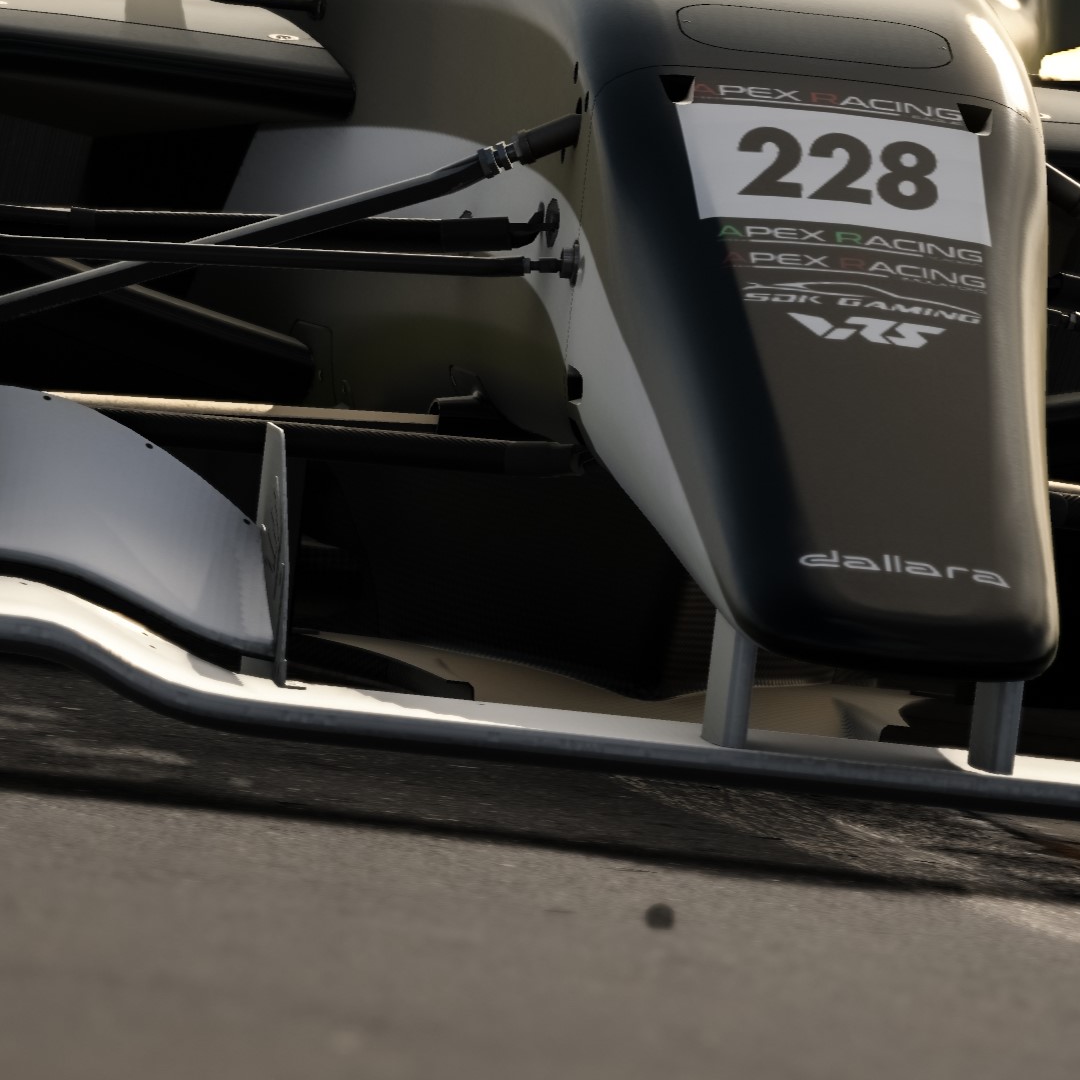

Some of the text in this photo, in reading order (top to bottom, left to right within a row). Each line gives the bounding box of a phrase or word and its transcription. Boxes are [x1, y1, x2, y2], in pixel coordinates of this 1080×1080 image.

[694, 83, 803, 102] APEX
[810, 91, 963, 121] RACING
[737, 126, 939, 211] 228
[718, 224, 983, 263] APEX RACING
[723, 251, 830, 268] APEX
[839, 258, 987, 289] RACING
[743, 292, 981, 324] SDK GAMING
[787, 312, 946, 348] VRS
[799, 550, 1011, 588] dallara
